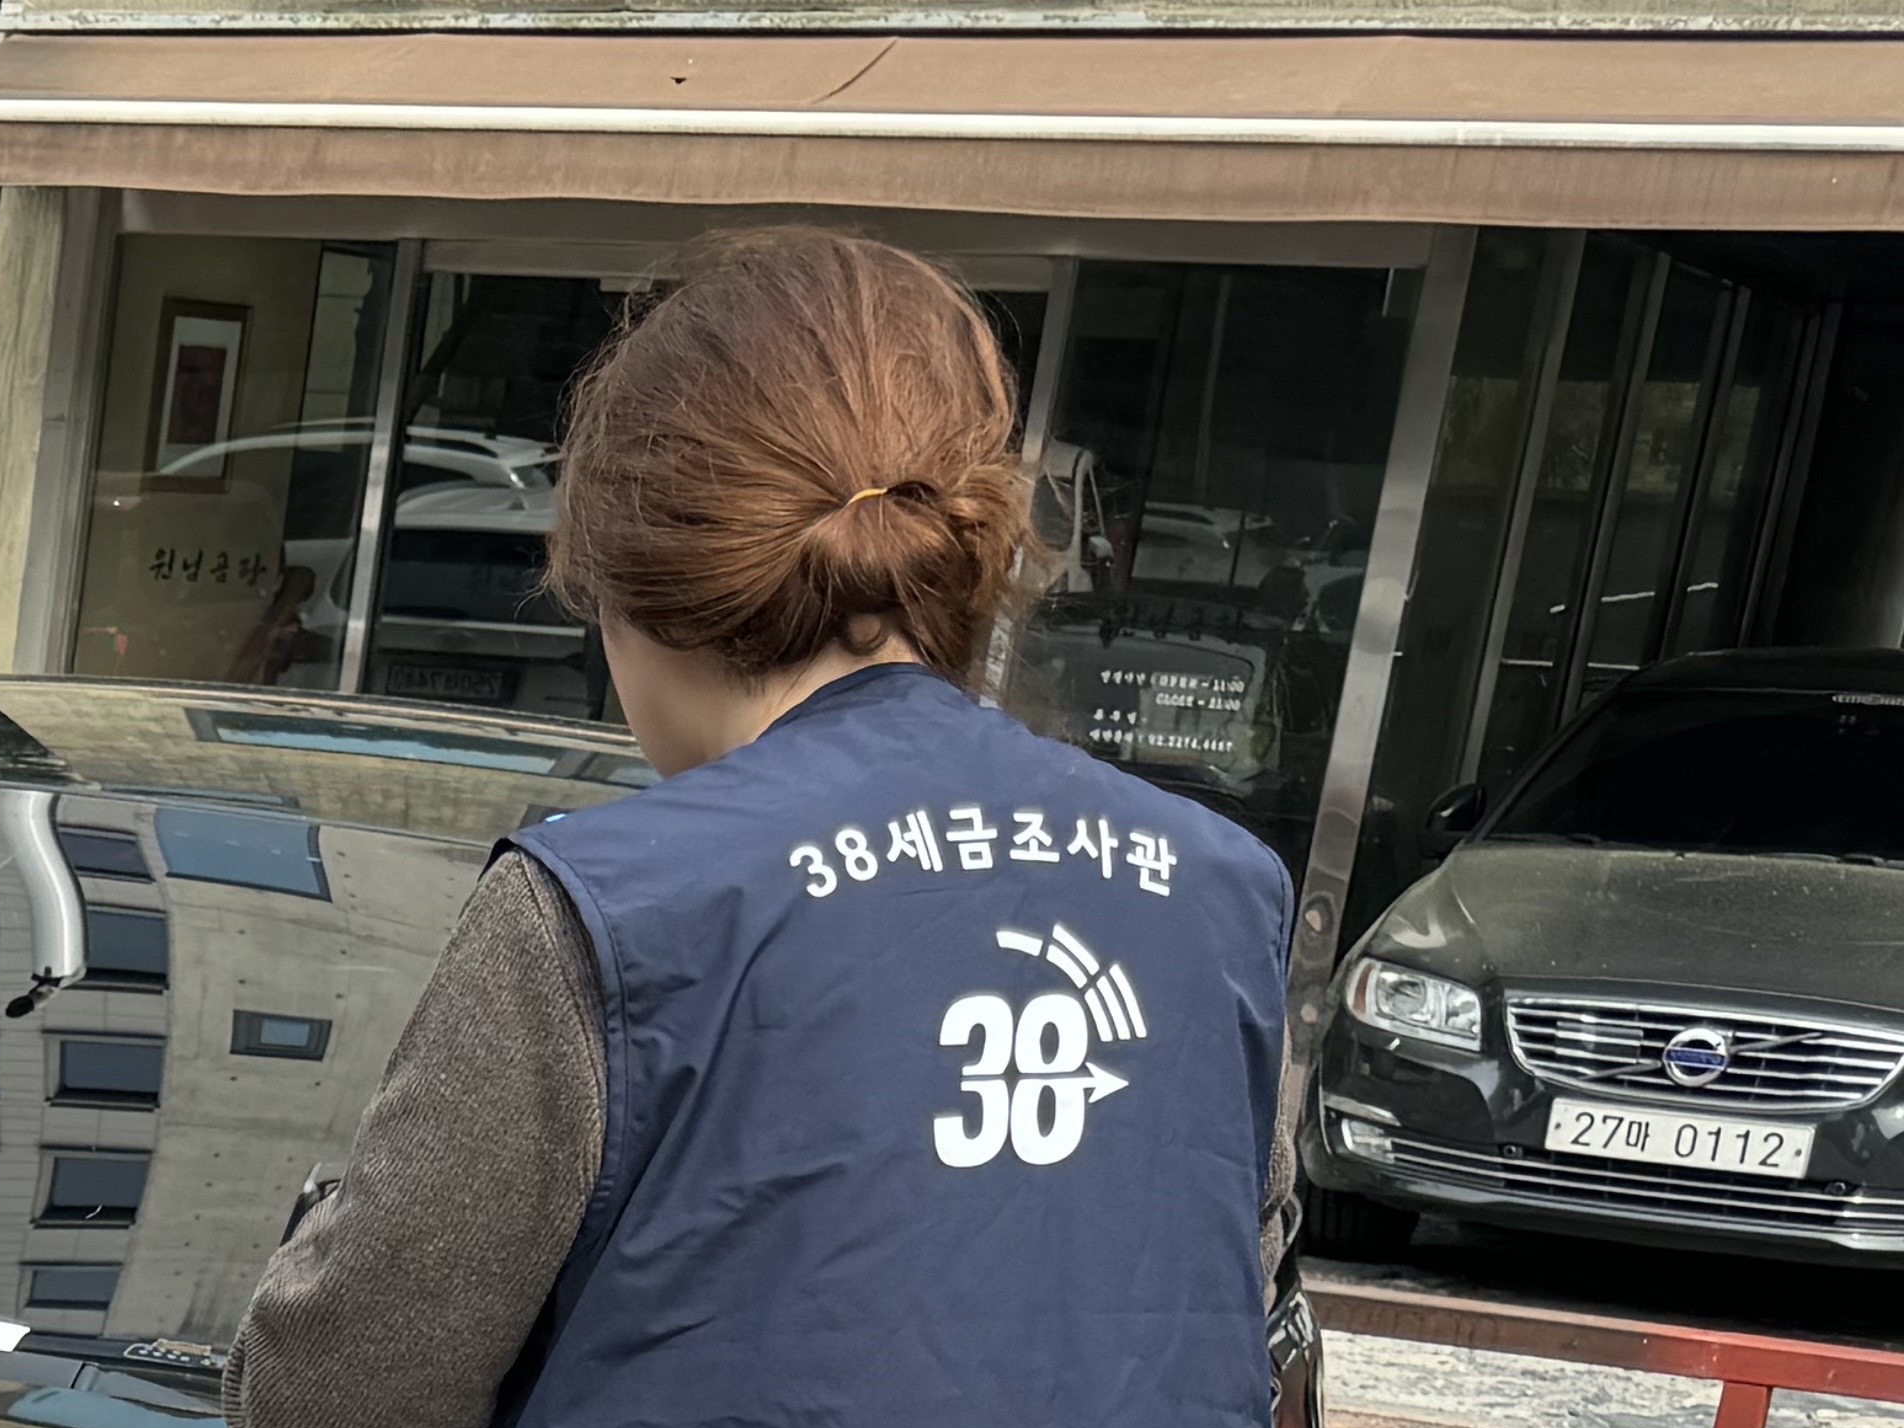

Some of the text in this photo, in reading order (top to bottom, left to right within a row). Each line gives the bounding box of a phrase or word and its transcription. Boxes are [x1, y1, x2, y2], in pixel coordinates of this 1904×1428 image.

[932, 993, 1090, 1168] 38
[1570, 1111, 1785, 1169] 27마 0112
